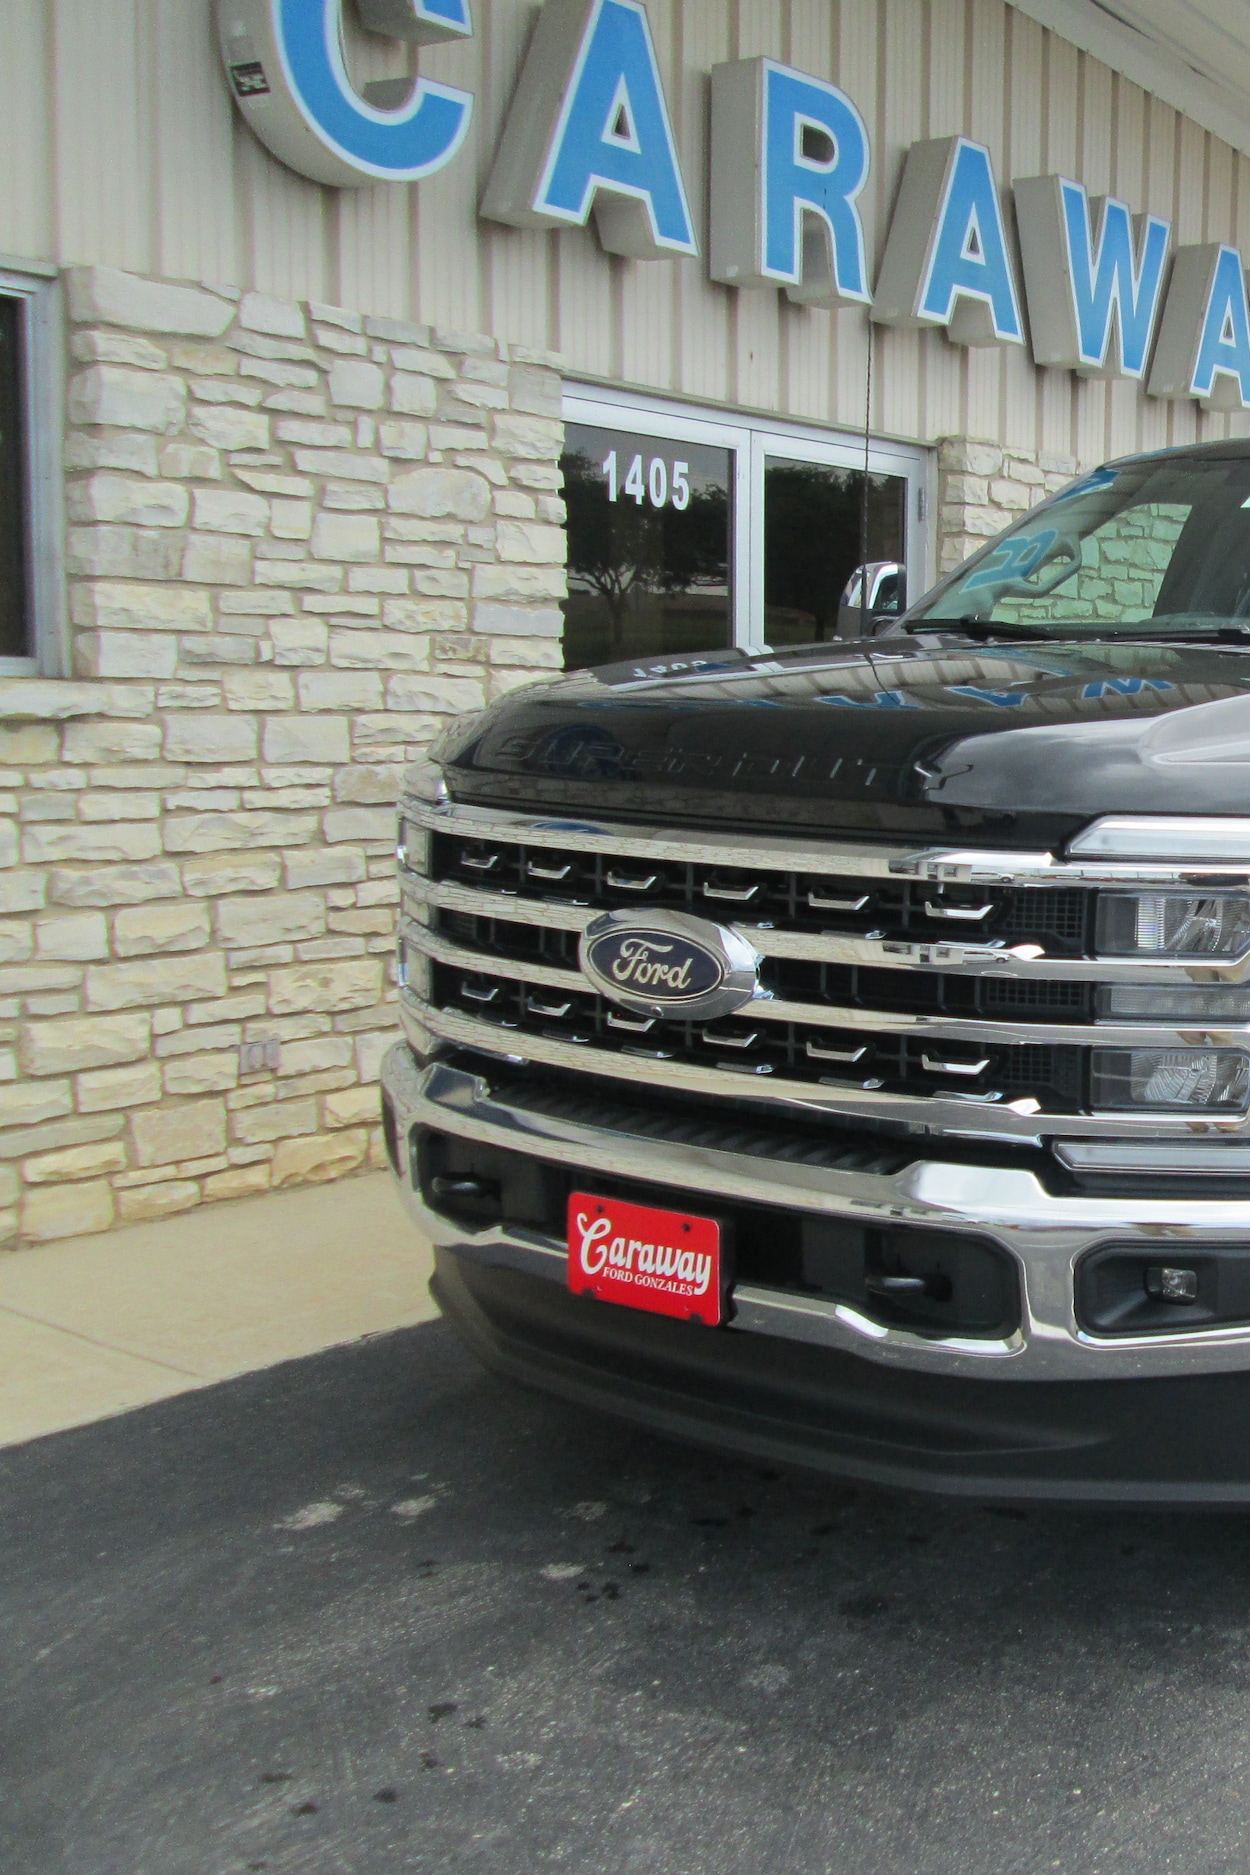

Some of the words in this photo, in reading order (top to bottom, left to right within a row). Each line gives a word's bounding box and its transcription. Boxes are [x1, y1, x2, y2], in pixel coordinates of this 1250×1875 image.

[602, 450, 690, 511] 1405
[612, 938, 694, 989] Ford
[577, 1212, 712, 1295] Caraway
[602, 1266, 633, 1283] FORD
[634, 1273, 694, 1296] GONZALES
